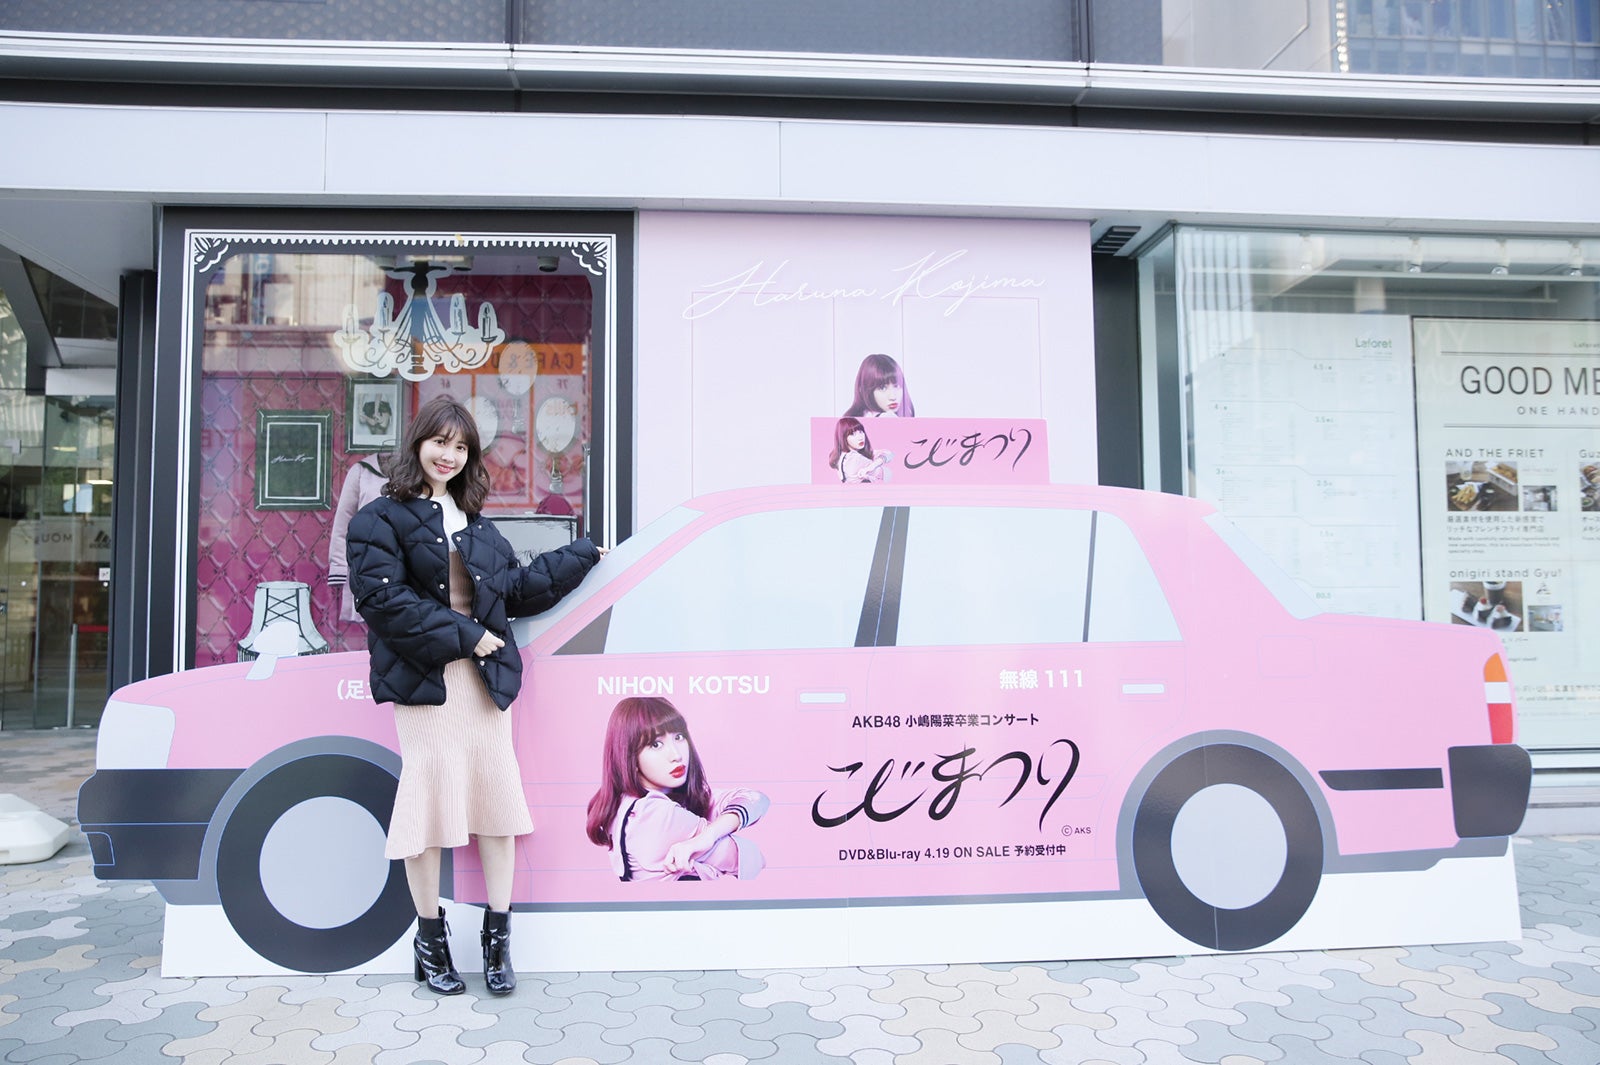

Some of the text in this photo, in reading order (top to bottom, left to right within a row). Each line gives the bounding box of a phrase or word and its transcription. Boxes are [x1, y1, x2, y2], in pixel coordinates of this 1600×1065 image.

[682, 249, 1046, 320] Haruna Kojima
[1460, 365, 1553, 395] GOOD
[1564, 367, 1600, 395] ME
[1516, 406, 1600, 417] ONE HAND
[903, 427, 1033, 473] こじまつり
[1445, 448, 1545, 459] AND THE FRIET
[1449, 568, 1491, 579] onigiri
[1495, 568, 1529, 578] stand
[597, 675, 770, 695] NIHON KOTSU
[1000, 668, 1084, 690] 無線 111
[851, 713, 1040, 728] AKB48 小嶋陽菜卒業コンサート
[811, 737, 1081, 834] こじまつり
[838, 844, 1067, 862] DVD&Blu-ray 4.19 ON SALE 予約受付中
